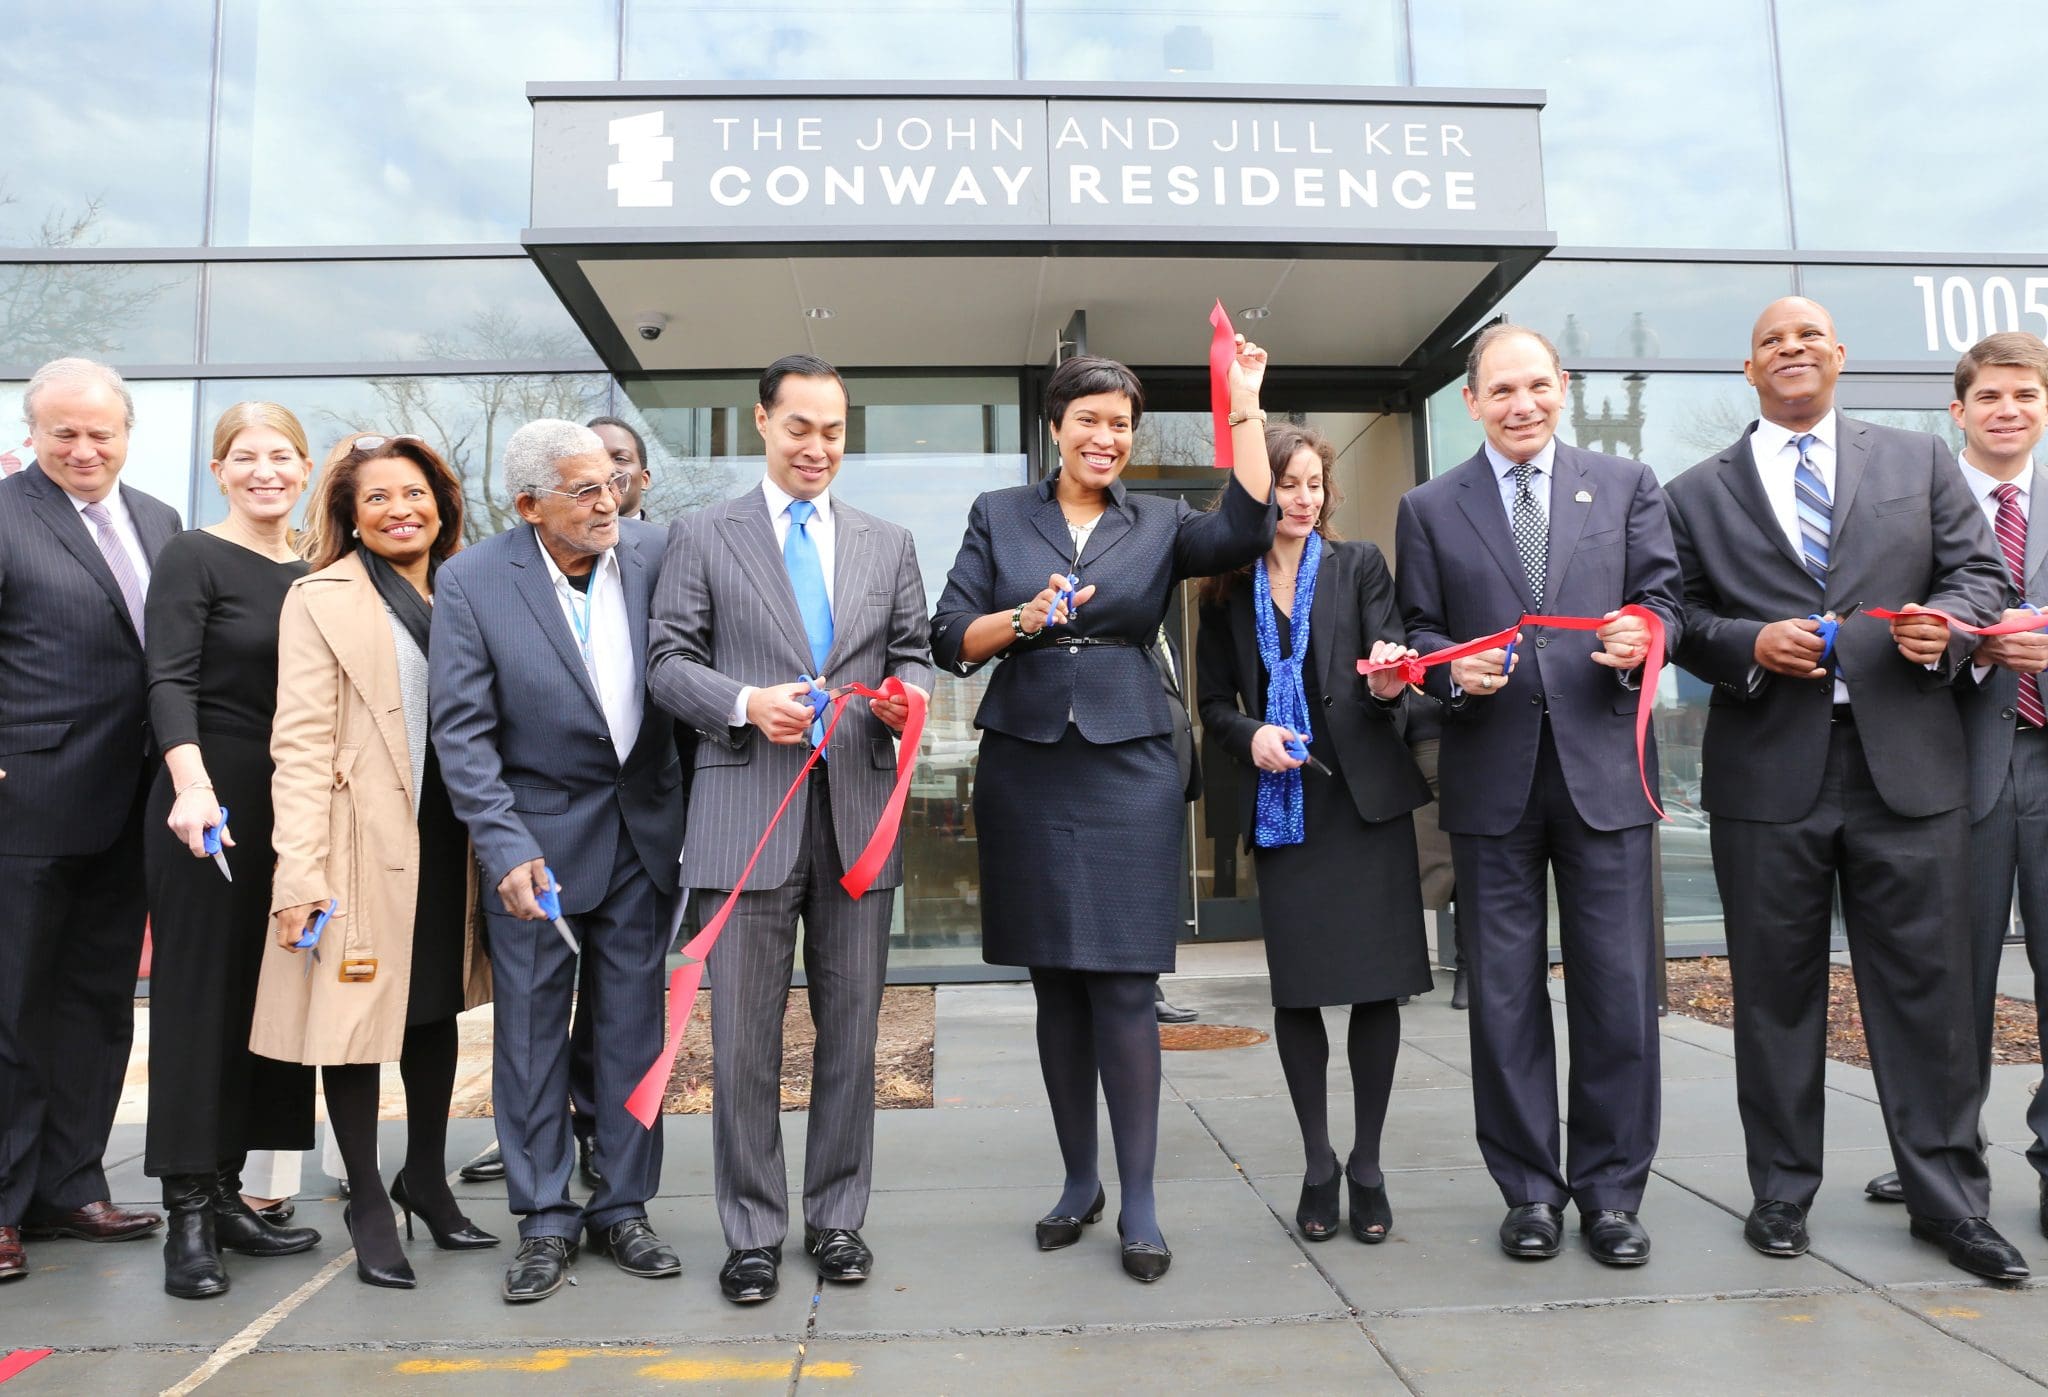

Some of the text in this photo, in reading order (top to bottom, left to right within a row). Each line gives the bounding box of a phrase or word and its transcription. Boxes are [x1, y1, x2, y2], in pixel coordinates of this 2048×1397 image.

[712, 117, 1473, 157] THE JOHN AND JILL KER
[709, 164, 1477, 210] CONWAY RESIDENCE
[1913, 275, 2048, 353] 1005
